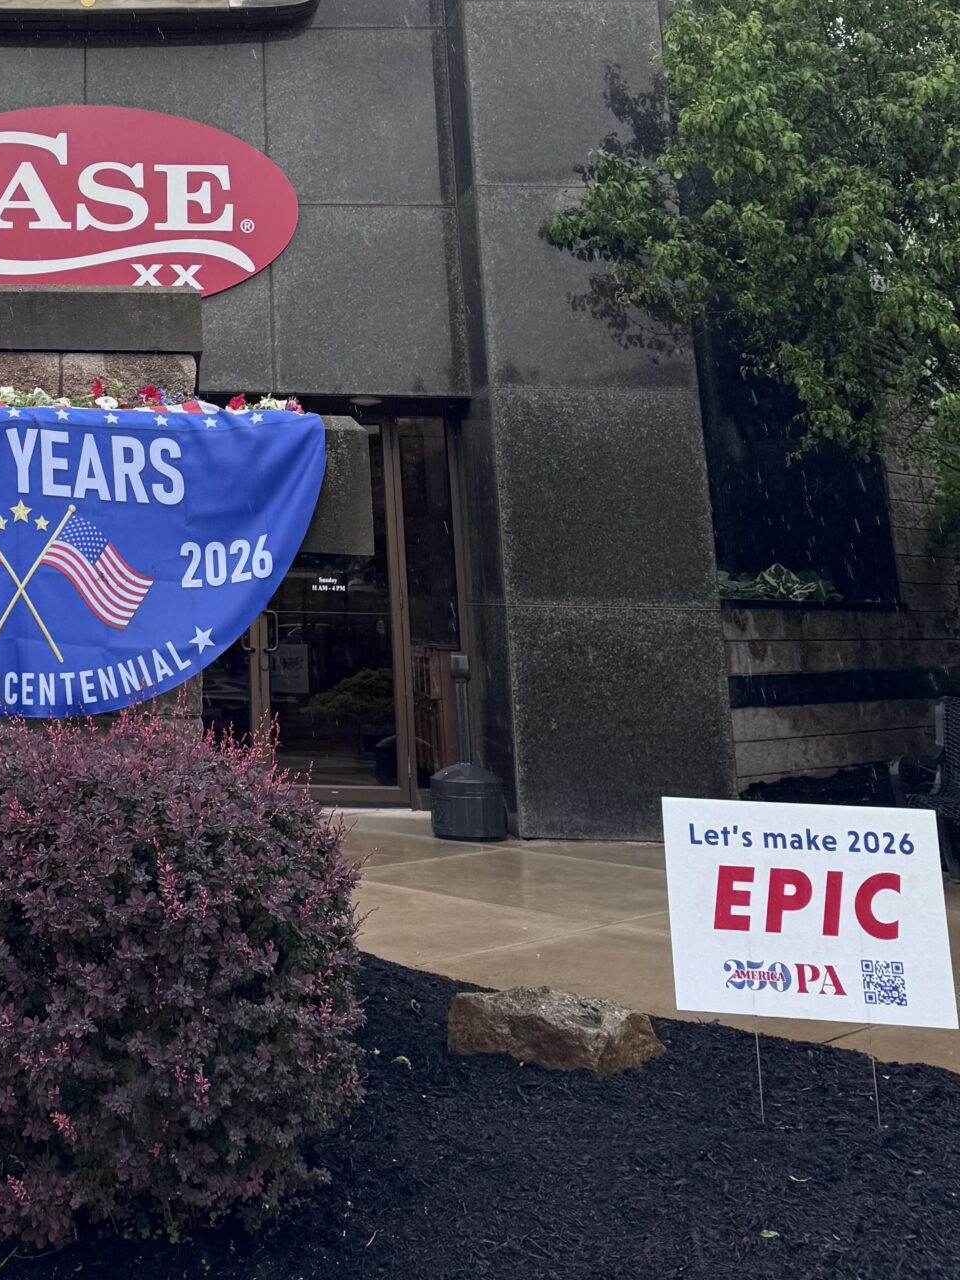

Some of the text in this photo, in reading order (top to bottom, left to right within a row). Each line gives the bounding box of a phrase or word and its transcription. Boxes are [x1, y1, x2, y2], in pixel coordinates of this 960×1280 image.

[6, 428, 185, 506] YEARS
[179, 533, 274, 589] 2026
[318, 576, 337, 584] Sunday
[689, 823, 915, 855] Let's make 2026
[713, 865, 901, 940] EPIC
[794, 963, 848, 996] PA
